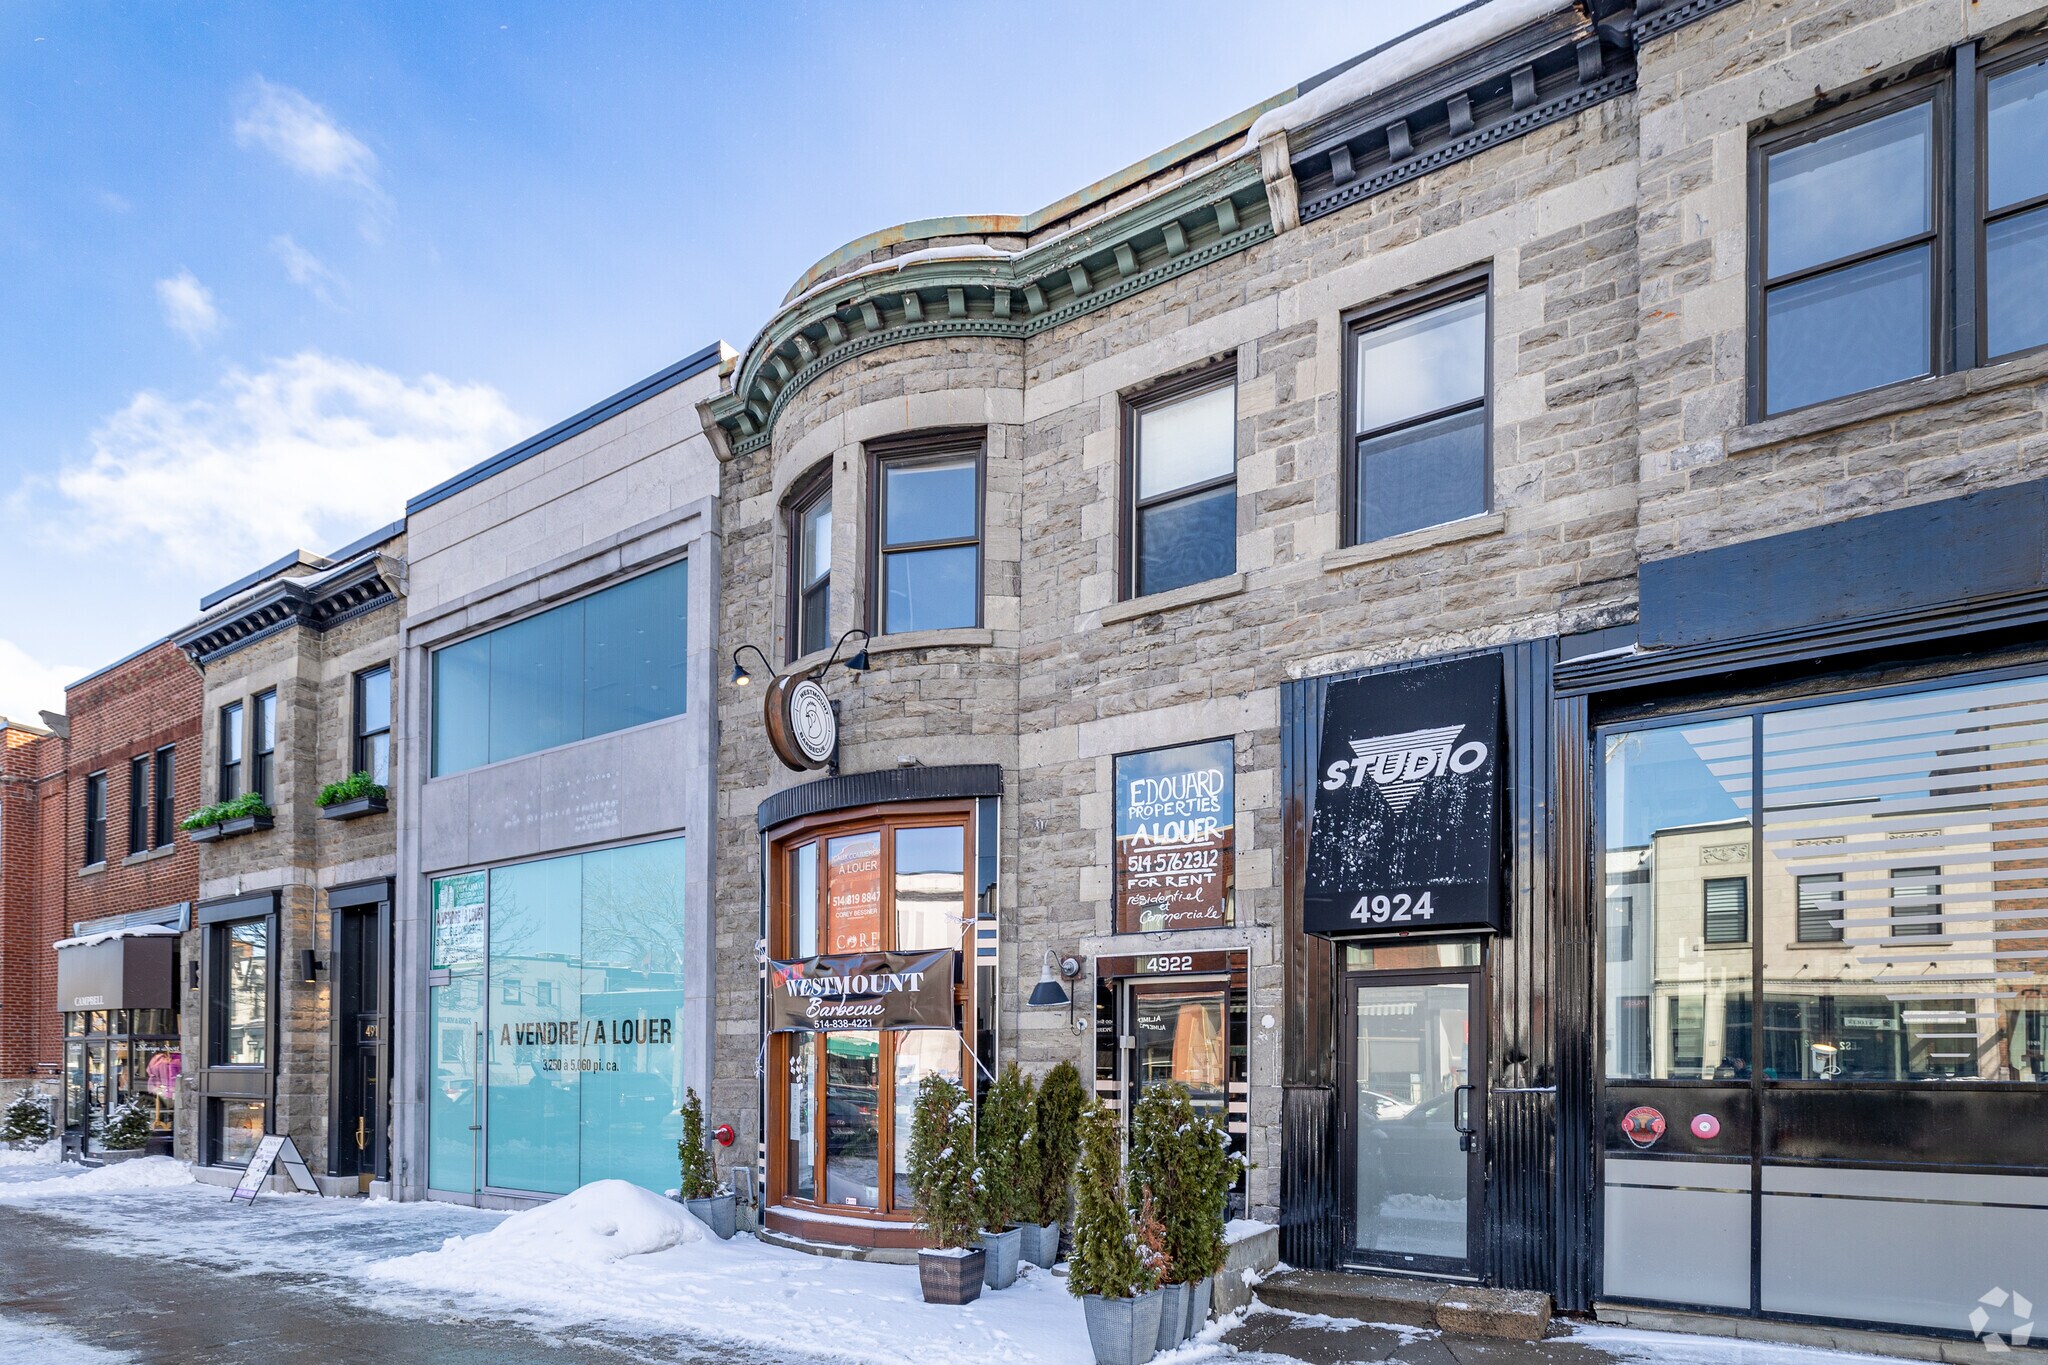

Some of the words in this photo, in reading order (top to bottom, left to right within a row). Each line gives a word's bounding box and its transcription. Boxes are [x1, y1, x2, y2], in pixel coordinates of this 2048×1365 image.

[800, 689, 829, 715] WESTMOUNT
[800, 731, 826, 754] BARBECUE
[1323, 741, 1488, 791] STUDIO
[1130, 769, 1224, 806] EDOUARD
[1128, 796, 1221, 820] PROPERTIES
[1130, 823, 1151, 847] A
[1152, 816, 1223, 844] LOUER
[847, 860, 878, 874] LOUER
[1127, 877, 1161, 890] FOR
[1165, 873, 1217, 888] RENT
[846, 893, 860, 905] 819
[861, 891, 880, 904] 8847
[1159, 902, 1171, 911] et
[1350, 891, 1434, 924] 4924
[835, 909, 853, 919] COREY
[836, 931, 879, 950] CORE
[1147, 956, 1193, 972] 4922
[785, 972, 924, 998] WESTMOUNT
[74, 995, 105, 1007] CAMPBELL
[806, 994, 885, 1018] Barbecue
[500, 1022, 511, 1046] A
[515, 1020, 579, 1046] VENDRE
[583, 1020, 590, 1047] /
[594, 1020, 607, 1045] A
[612, 1018, 672, 1045] LOUER
[814, 1018, 873, 1029] 514-838-4221
[542, 1059, 562, 1072] 3,250
[563, 1059, 569, 1071] à
[570, 1059, 592, 1072] 5,060
[593, 1059, 604, 1074] pi.
[606, 1060, 620, 1072] ca.
